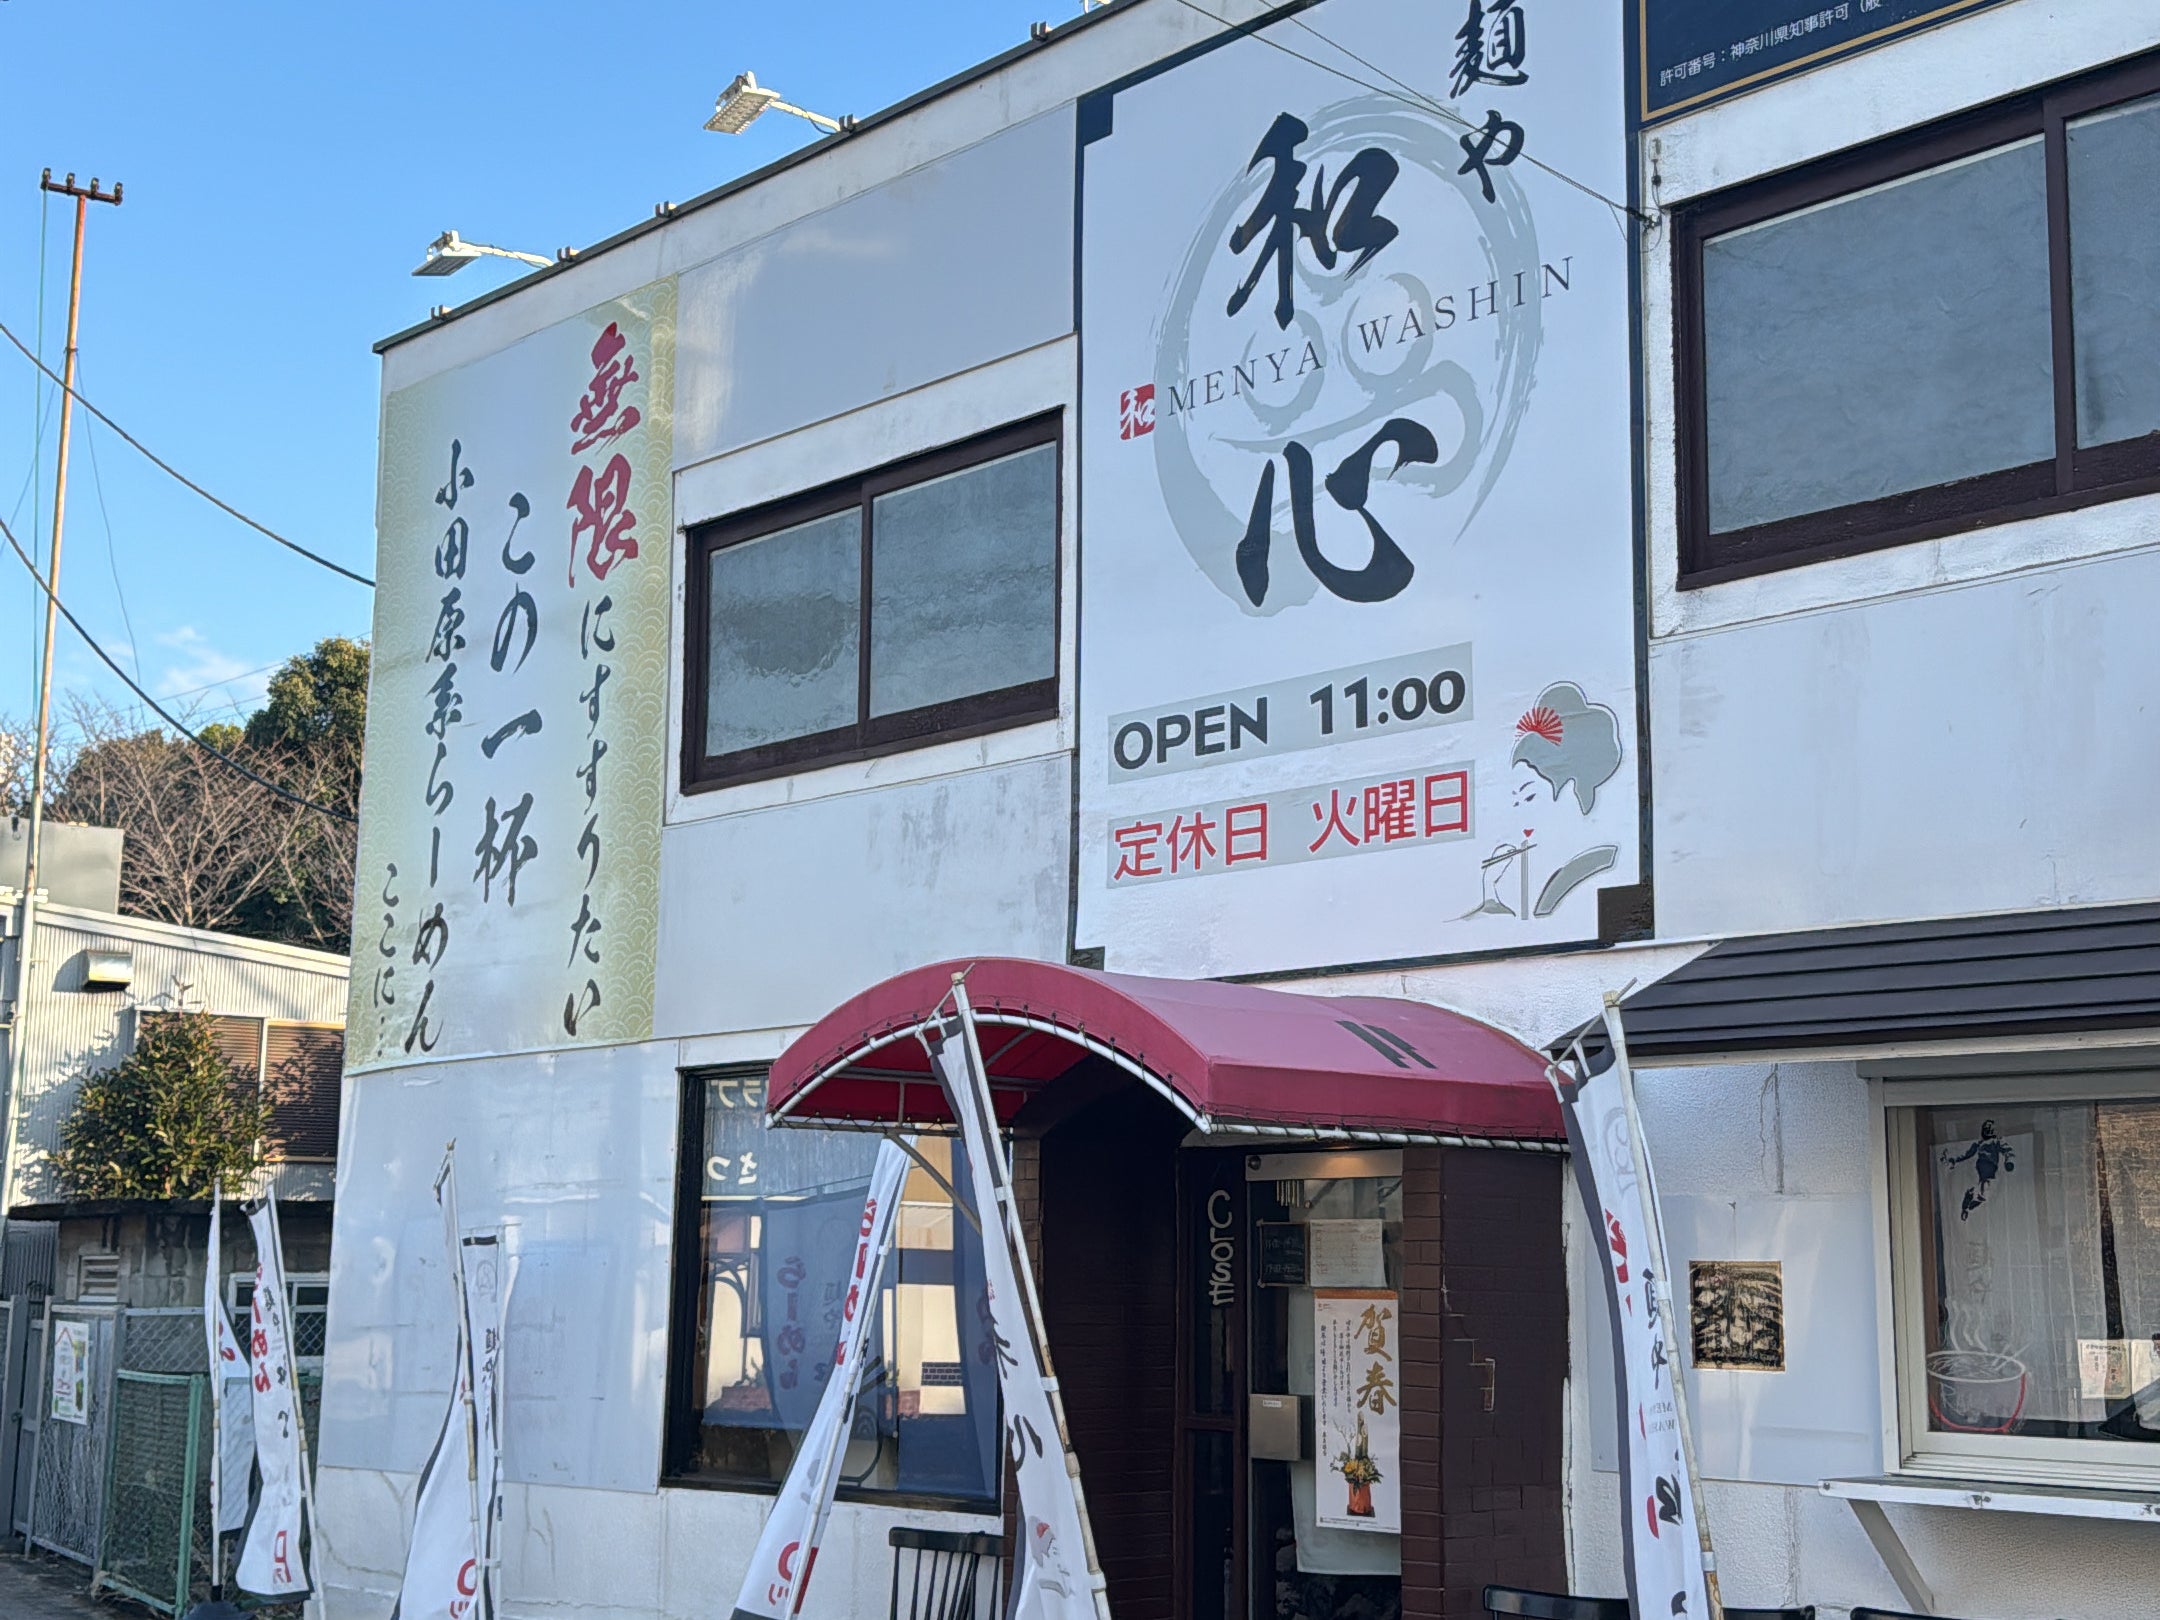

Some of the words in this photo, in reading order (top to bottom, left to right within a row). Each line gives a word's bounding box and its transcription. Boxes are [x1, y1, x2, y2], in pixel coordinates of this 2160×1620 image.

[1167, 340, 1323, 417] MENYA
[1357, 256, 1573, 354] WASHIN
[1226, 112, 1439, 607] 和心
[1120, 383, 1155, 440] 和
[473, 492, 543, 907] この一杯
[1113, 696, 1268, 770] OPEN
[1309, 669, 1466, 735] 11:00
[1113, 802, 1268, 881] 定休日
[1308, 769, 1469, 854] 火曜日
[1353, 1303, 1398, 1415] 賀春
